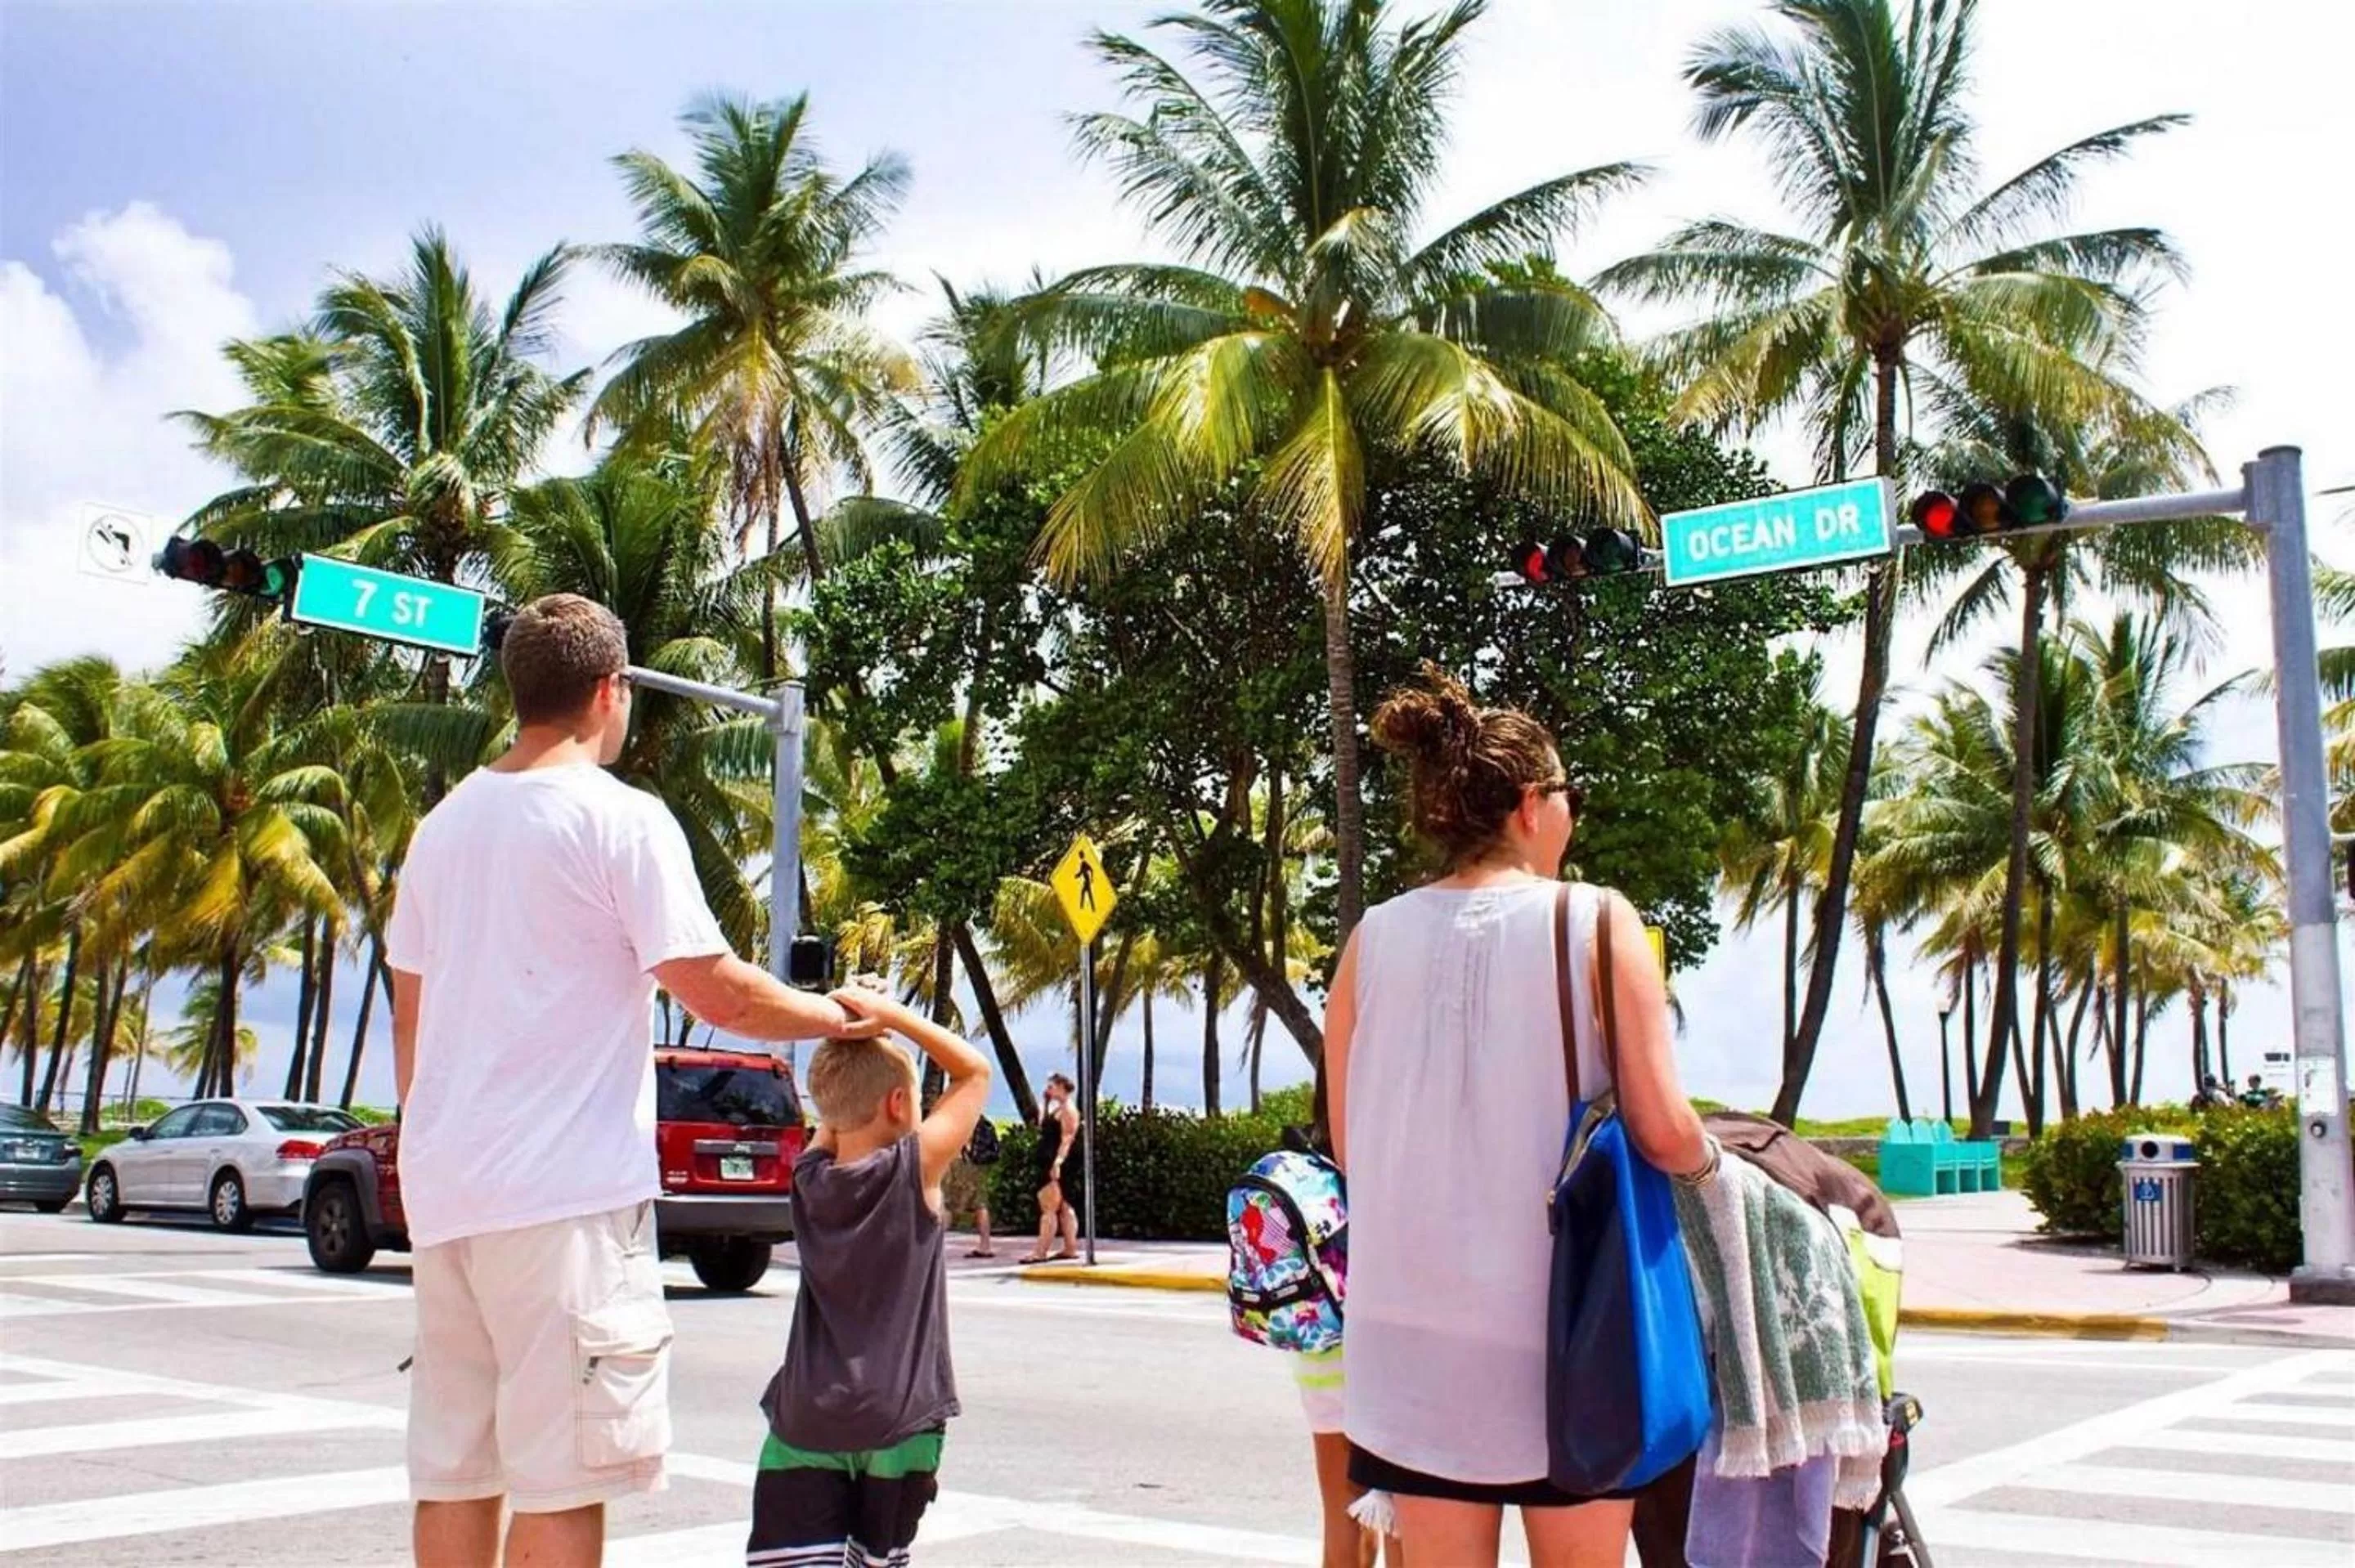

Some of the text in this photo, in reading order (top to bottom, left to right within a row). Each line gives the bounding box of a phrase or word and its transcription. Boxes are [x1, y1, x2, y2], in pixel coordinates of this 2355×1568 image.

[1688, 503, 1861, 562] OCEAN DR
[352, 579, 433, 628] 7 ST
